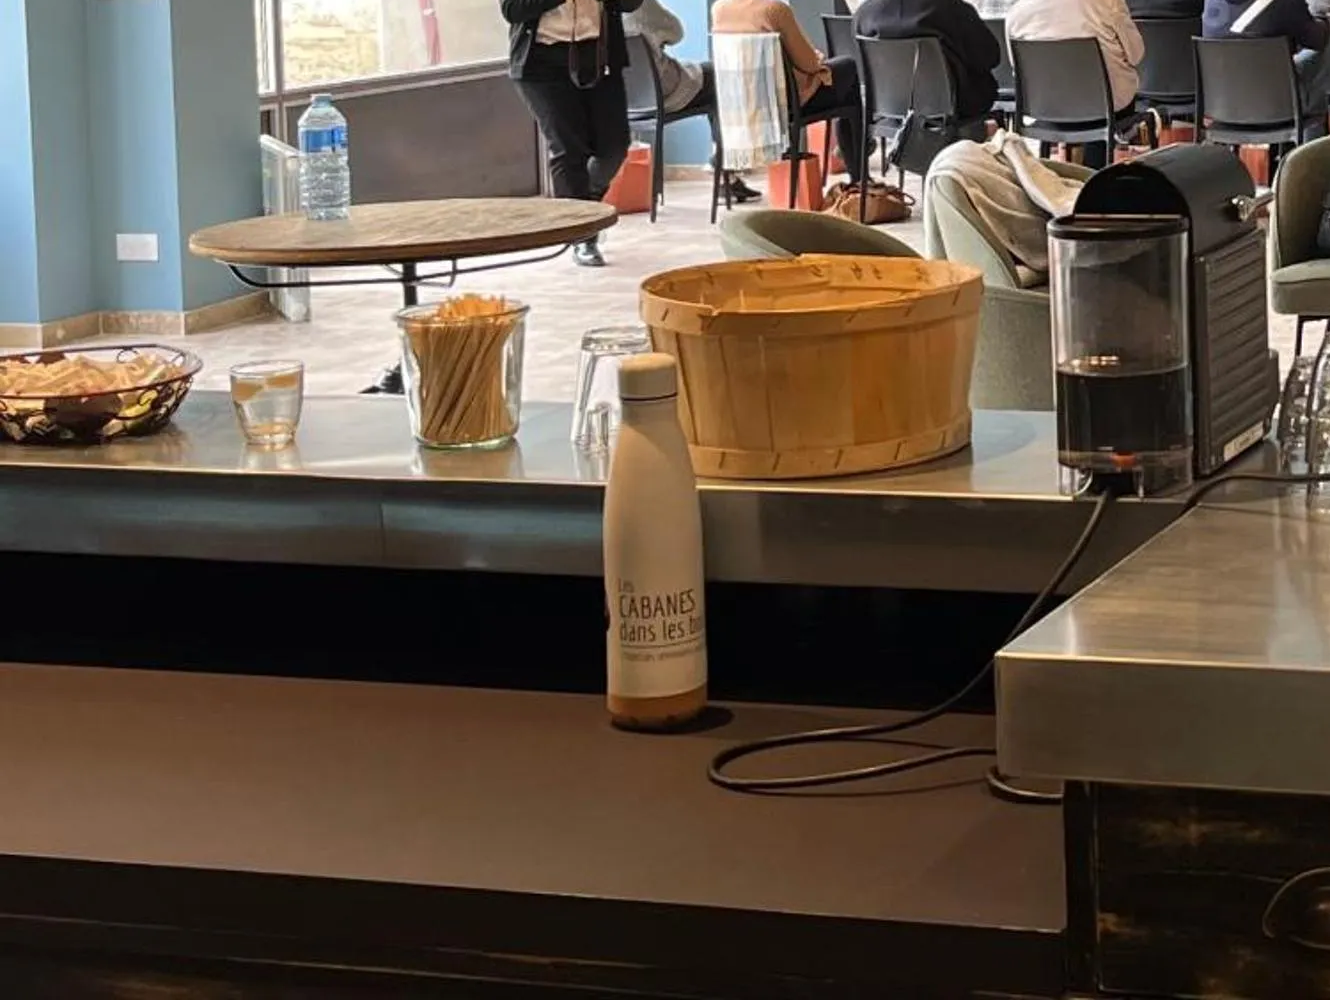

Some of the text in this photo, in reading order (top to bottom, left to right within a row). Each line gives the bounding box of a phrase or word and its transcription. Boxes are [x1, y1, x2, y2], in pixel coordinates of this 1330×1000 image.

[619, 588, 697, 620] CABANES
[619, 620, 657, 642] dans
[662, 618, 685, 641] les
